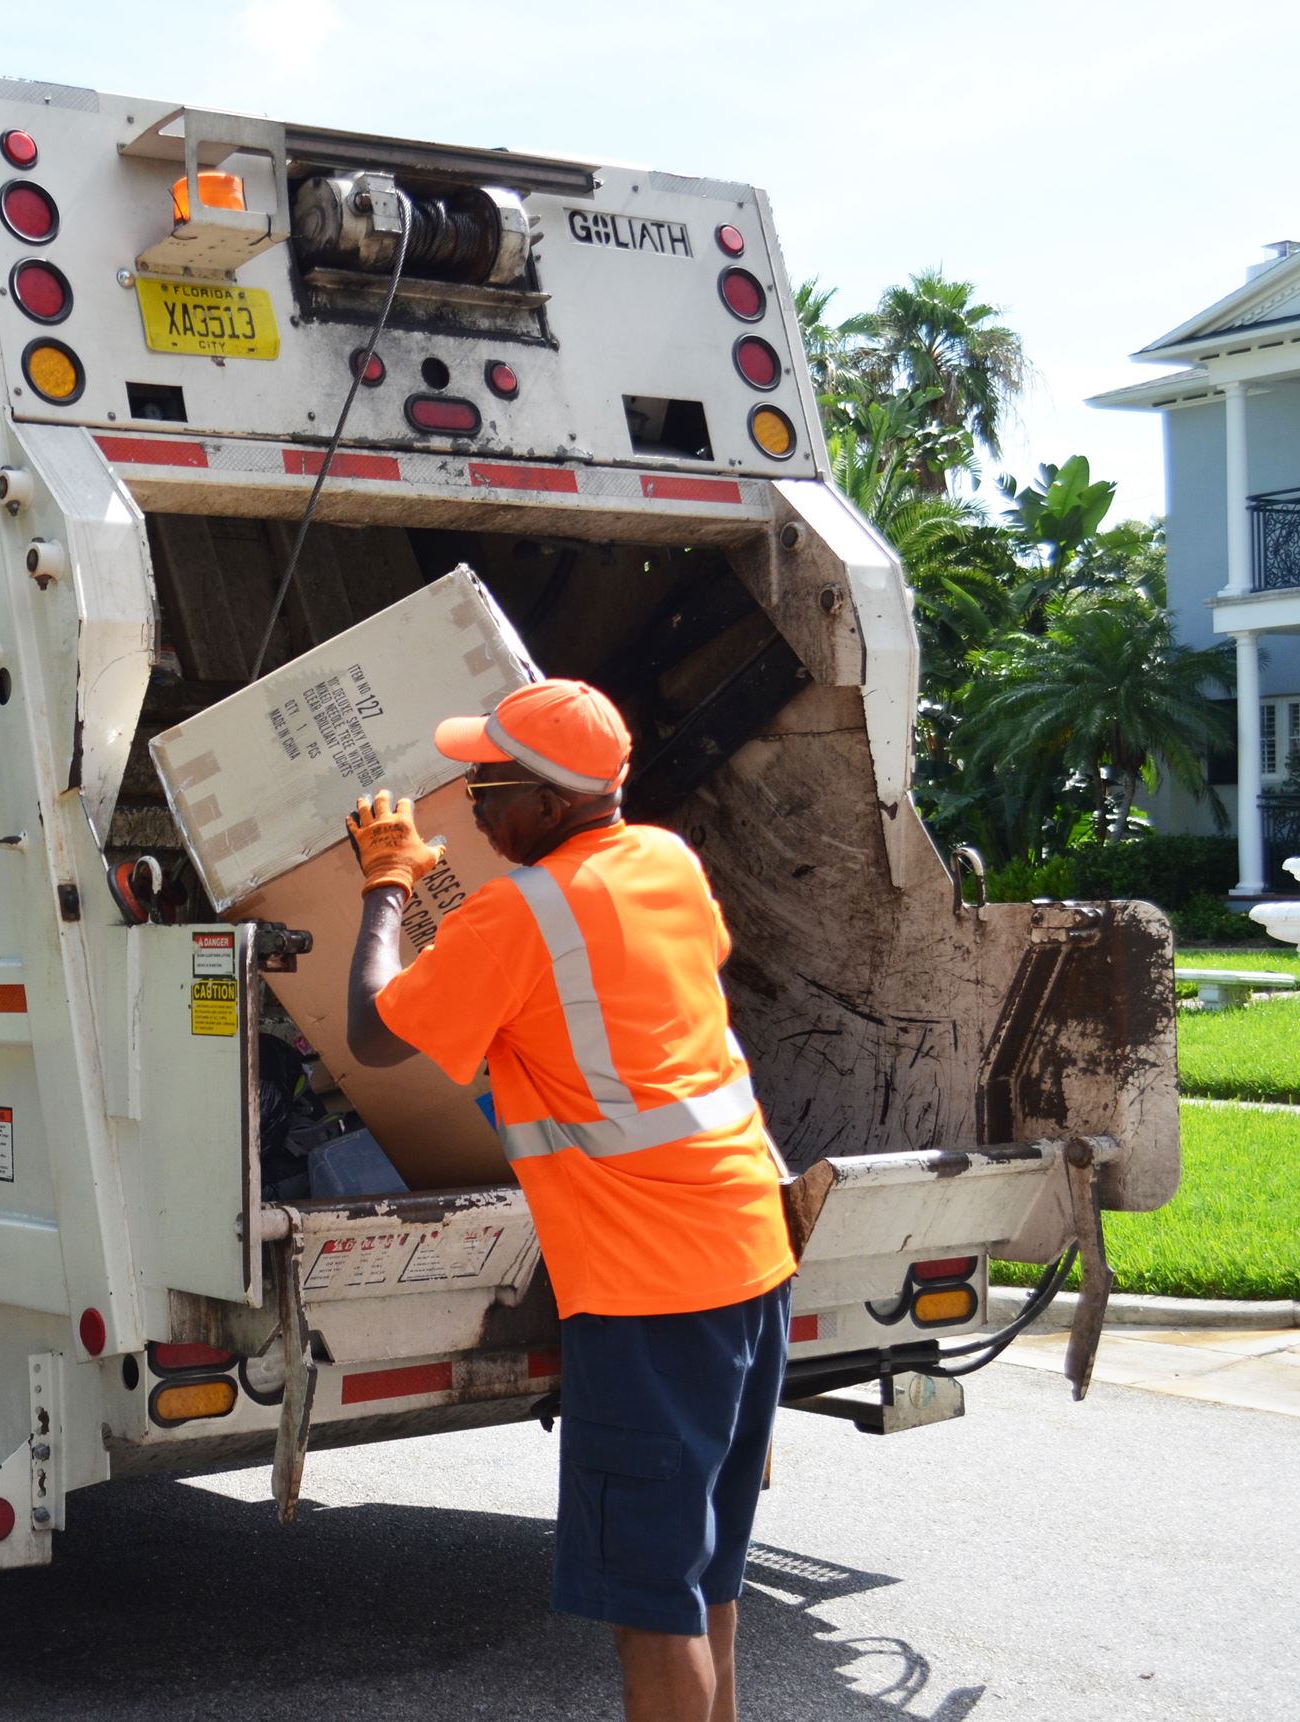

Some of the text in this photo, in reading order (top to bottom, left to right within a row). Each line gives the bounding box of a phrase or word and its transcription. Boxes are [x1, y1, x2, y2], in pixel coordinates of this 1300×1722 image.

[568, 210, 689, 256] GOLIATH
[173, 286, 234, 299] FLORIDA
[163, 301, 256, 339] XA3513
[198, 340, 226, 353] CITY
[348, 664, 365, 682] ITEM
[355, 694, 384, 720] 127
[268, 708, 301, 761] MADE IN CHINA
[296, 723, 307, 732] 1
[306, 741, 321, 759] PCS
[303, 688, 354, 778] CLEAR BRILLIANT LIGHTS
[314, 681, 374, 788] MIXED NEEDLE TREE WITH 1900
[332, 688, 354, 716] DELUXE
[346, 716, 368, 741] SMOKY
[359, 742, 386, 780] MOUNTAIN
[204, 938, 229, 947] DANGER
[194, 984, 234, 999] CAUTION
